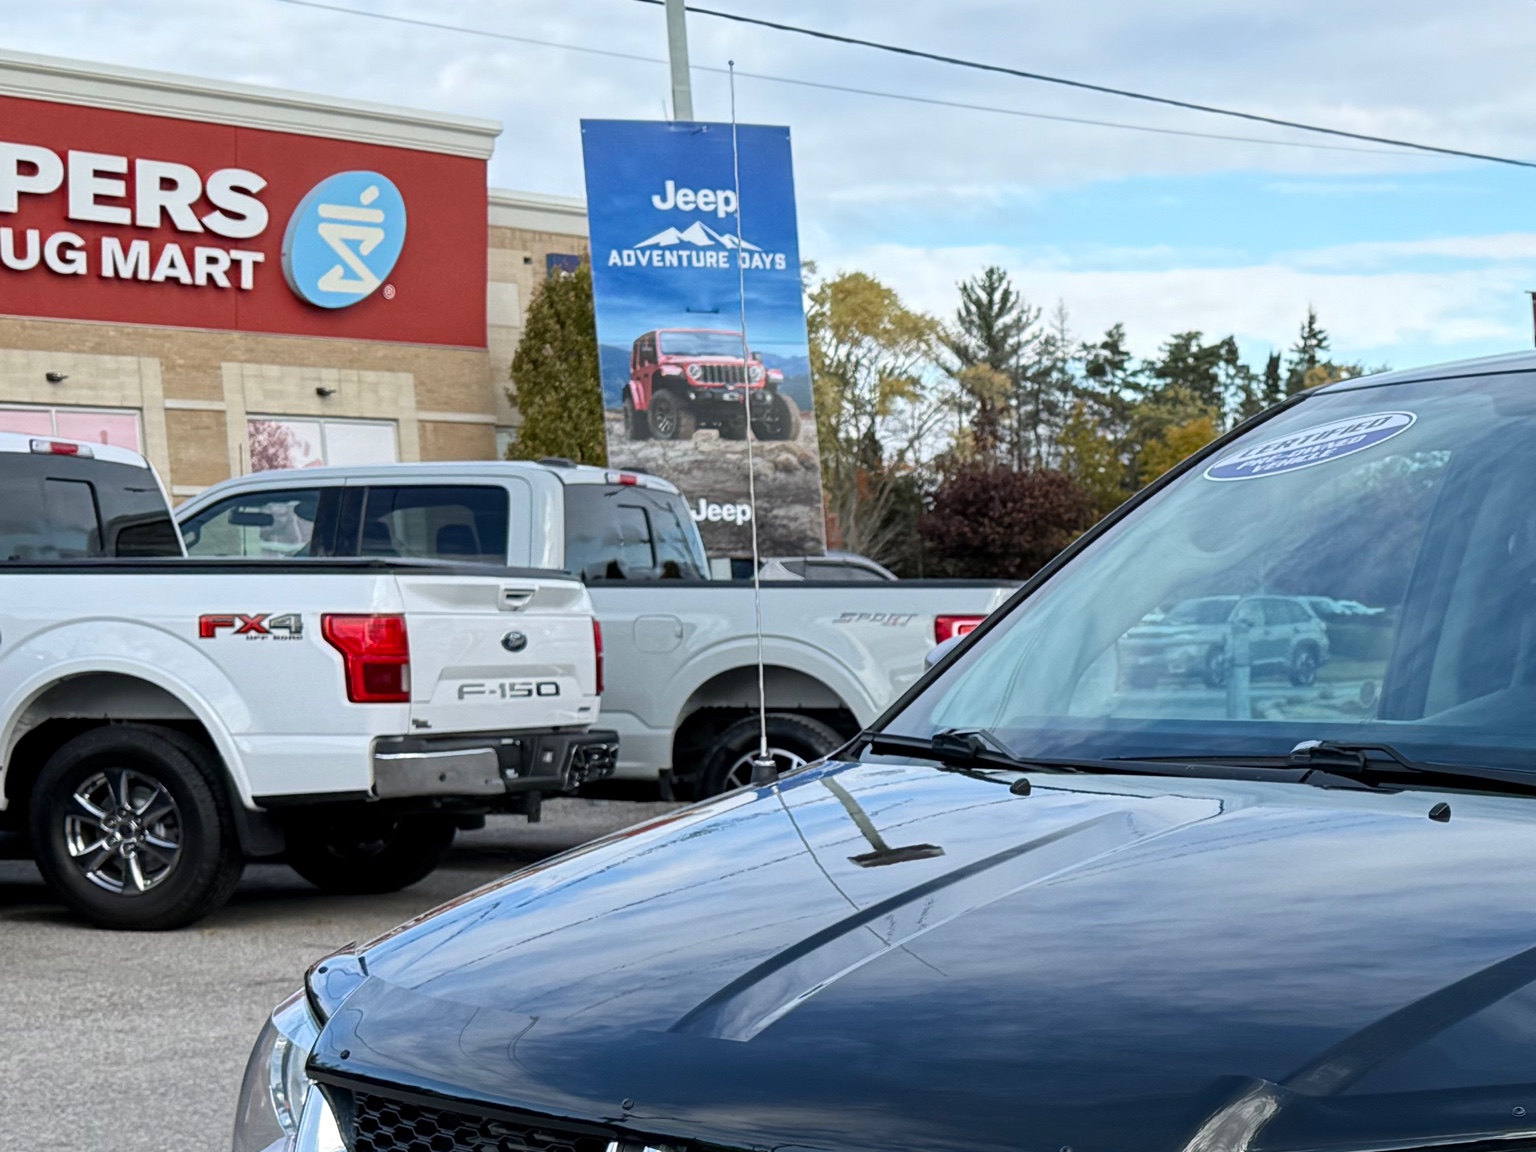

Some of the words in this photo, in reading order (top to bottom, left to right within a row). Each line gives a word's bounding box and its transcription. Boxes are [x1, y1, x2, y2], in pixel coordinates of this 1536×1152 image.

[0, 141, 269, 239] PERS
[651, 180, 739, 218] Jeep
[0, 227, 88, 275] UG
[101, 236, 266, 290] MART
[608, 249, 730, 268] ADVENTURE
[738, 251, 787, 270] DAYS
[1239, 415, 1393, 459] CERTIFIED
[1236, 434, 1368, 470] PRE-OWNED
[1251, 448, 1338, 473] VEHICLE
[690, 498, 752, 526] Jeep
[199, 613, 303, 638] FX4
[832, 612, 919, 627] SPORT
[457, 681, 561, 700] F-150
